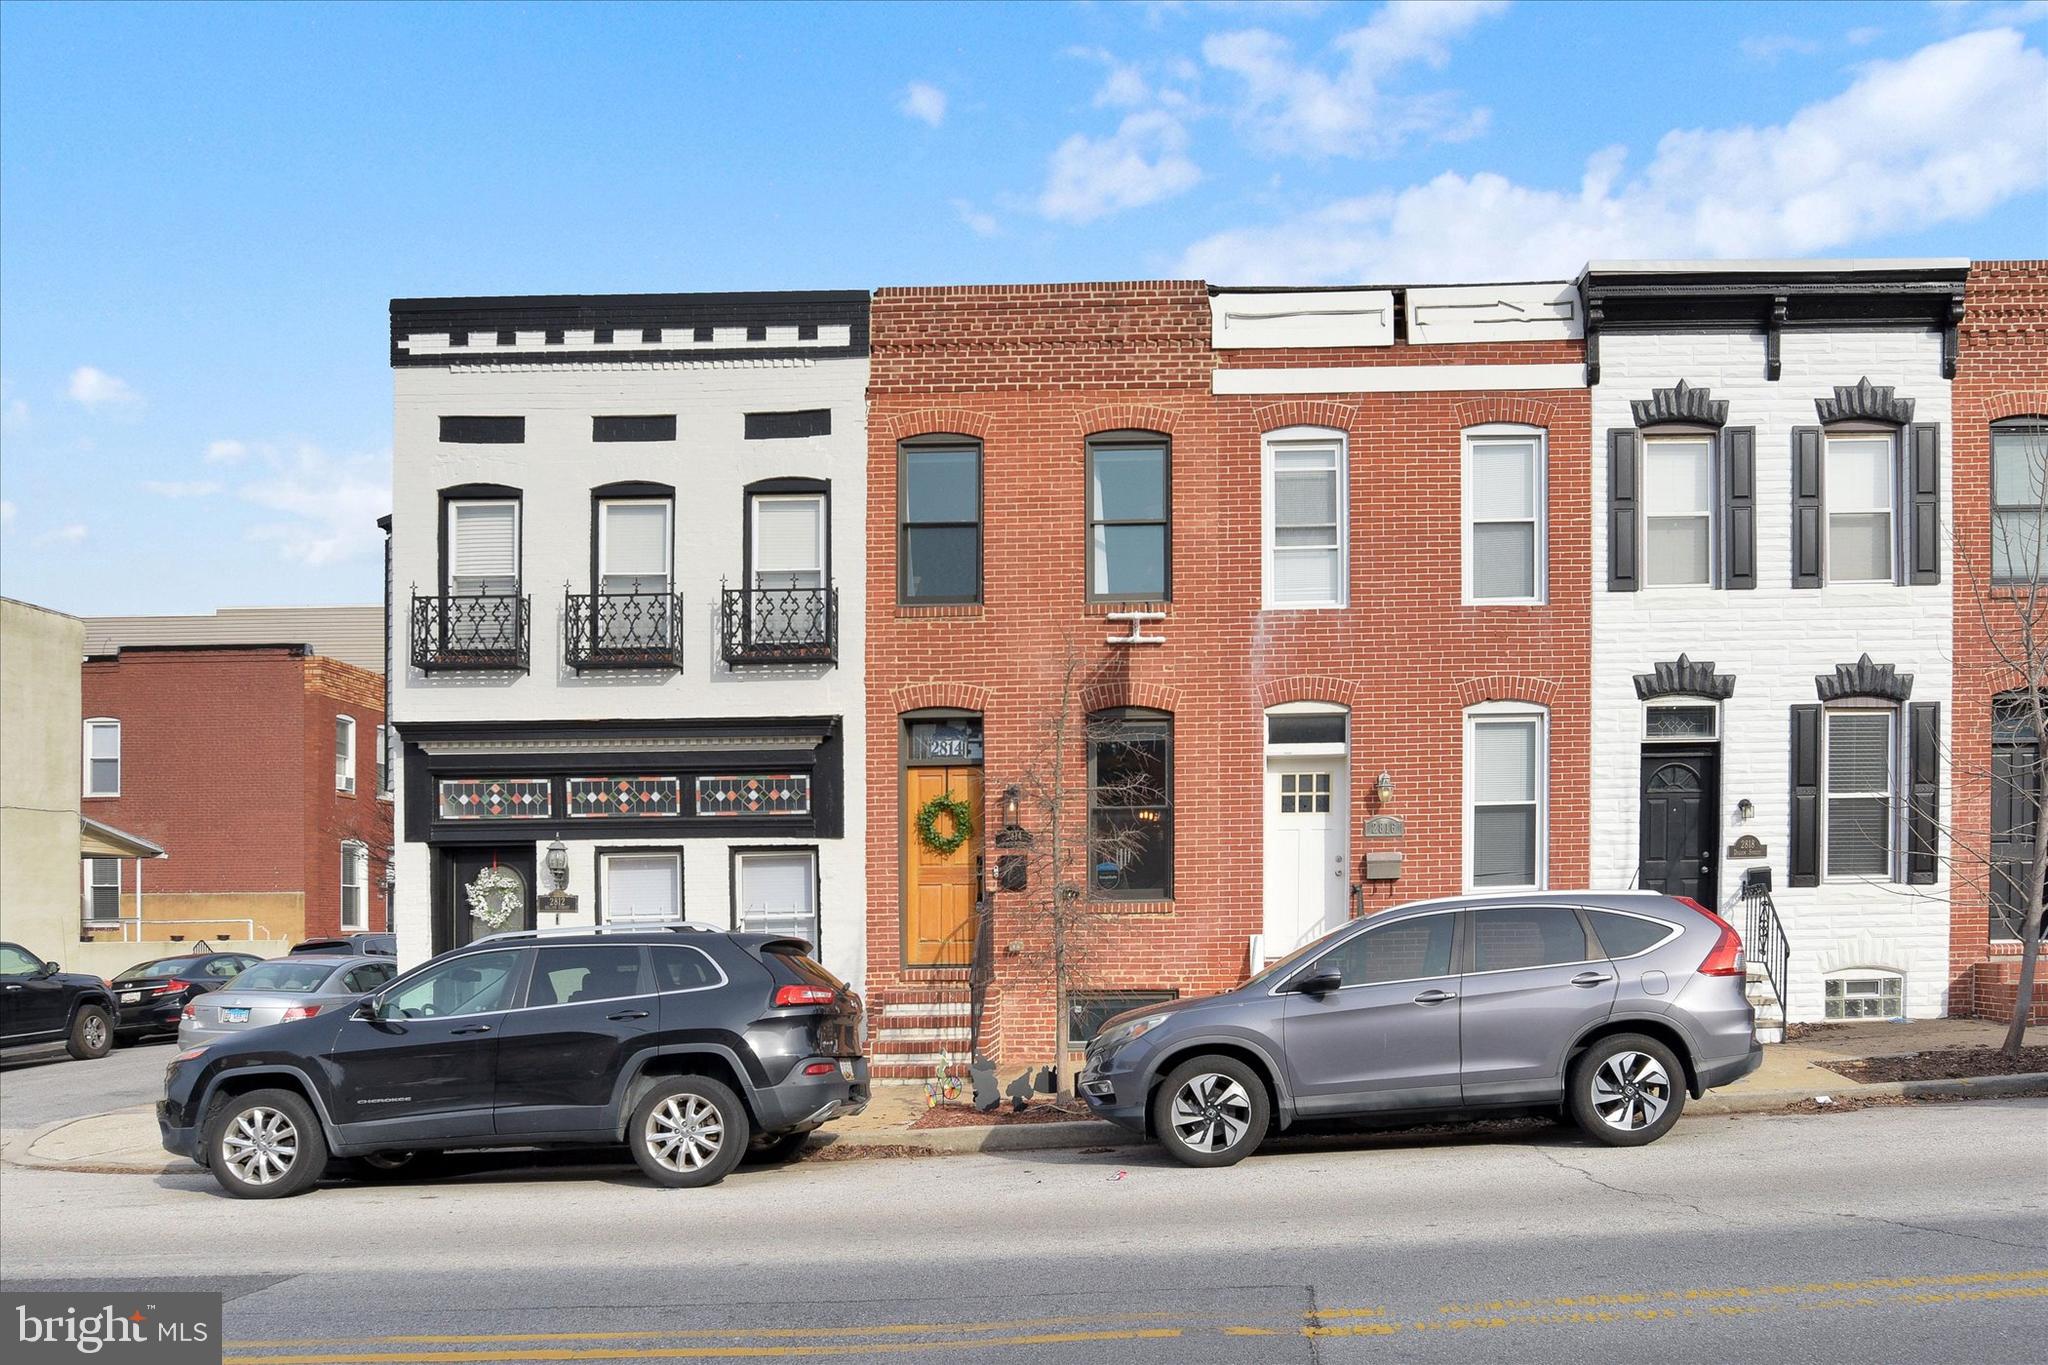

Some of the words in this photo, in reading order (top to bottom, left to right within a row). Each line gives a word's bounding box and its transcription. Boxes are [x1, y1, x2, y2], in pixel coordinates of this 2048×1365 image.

[930, 740, 963, 757] 2814
[1371, 821, 1396, 835] 2816
[1740, 839, 1756, 849] 2818
[549, 897, 566, 906] 2812
[357, 1096, 412, 1105] CHEROKEE
